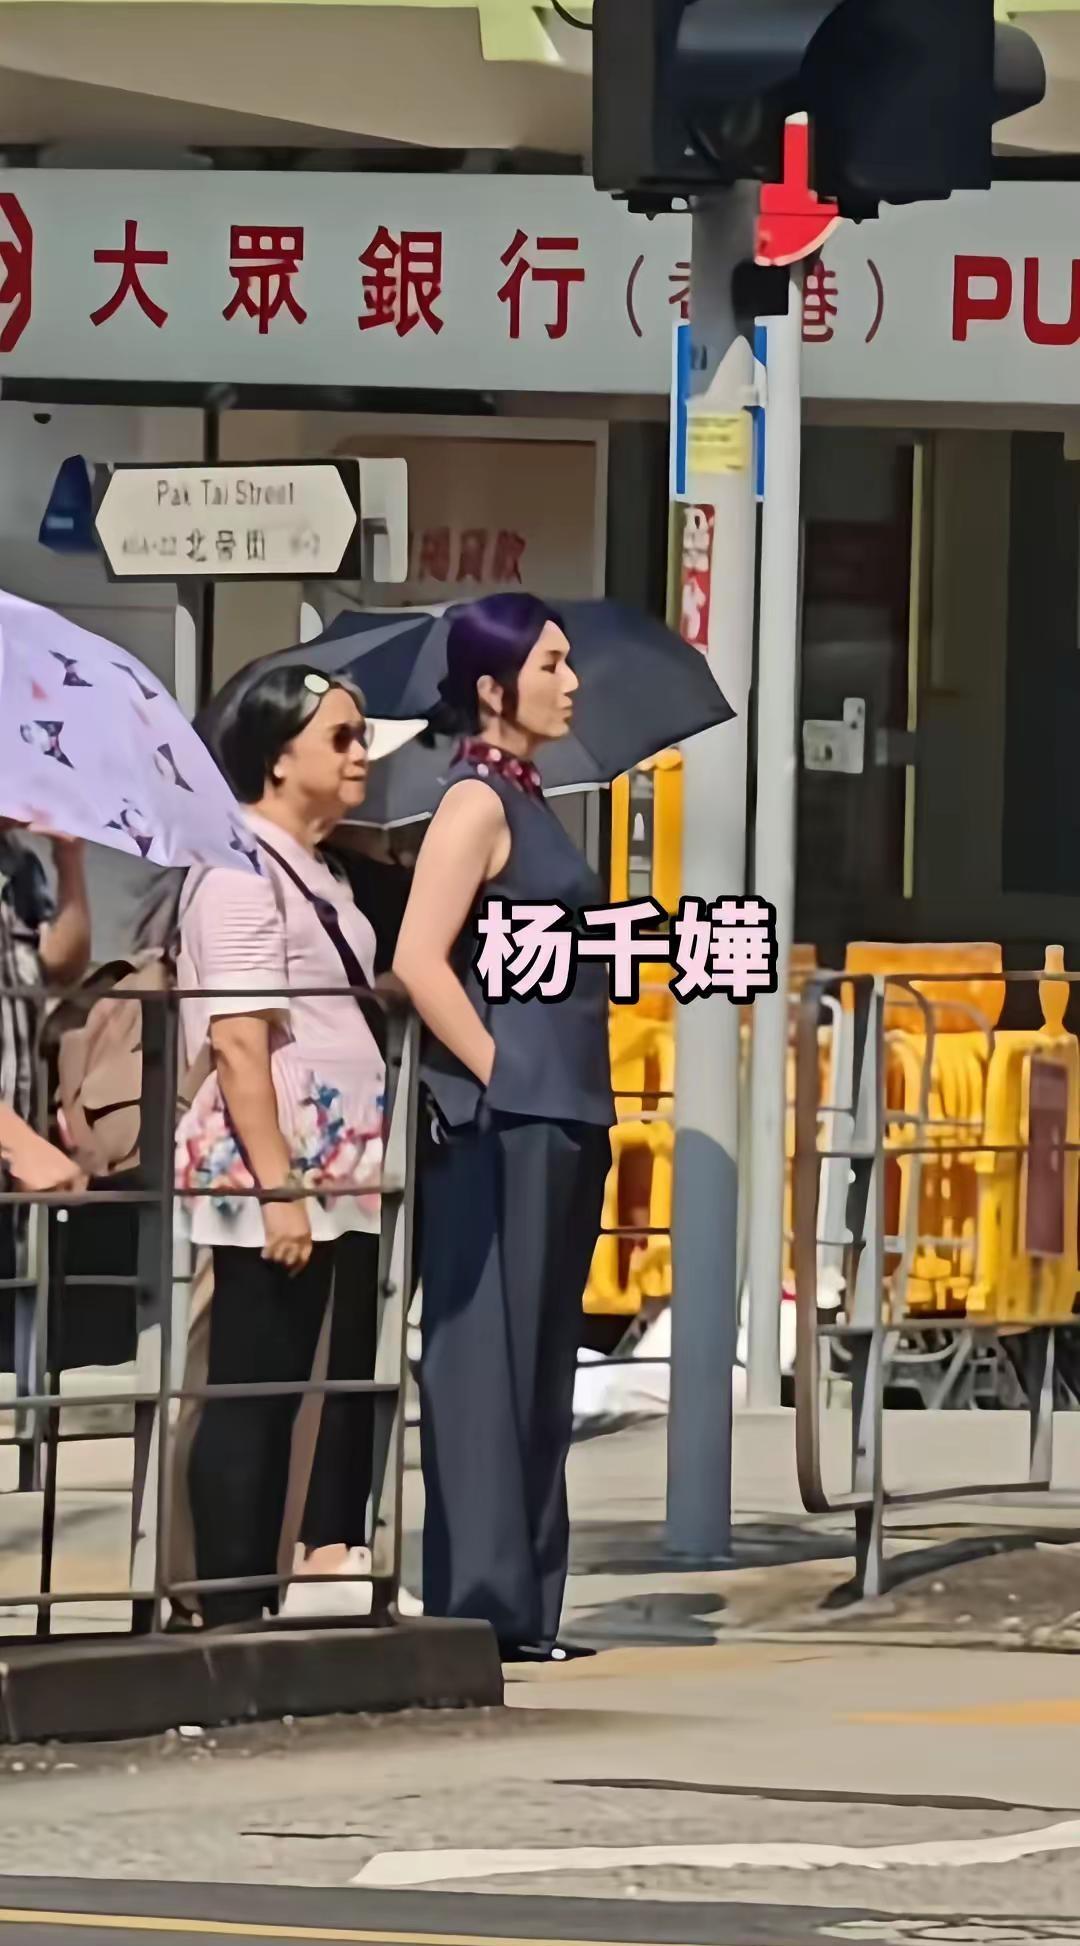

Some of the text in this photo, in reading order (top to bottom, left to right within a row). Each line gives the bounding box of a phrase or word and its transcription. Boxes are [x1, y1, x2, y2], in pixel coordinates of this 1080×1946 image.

[157, 479, 295, 507] Pak Tai Street
